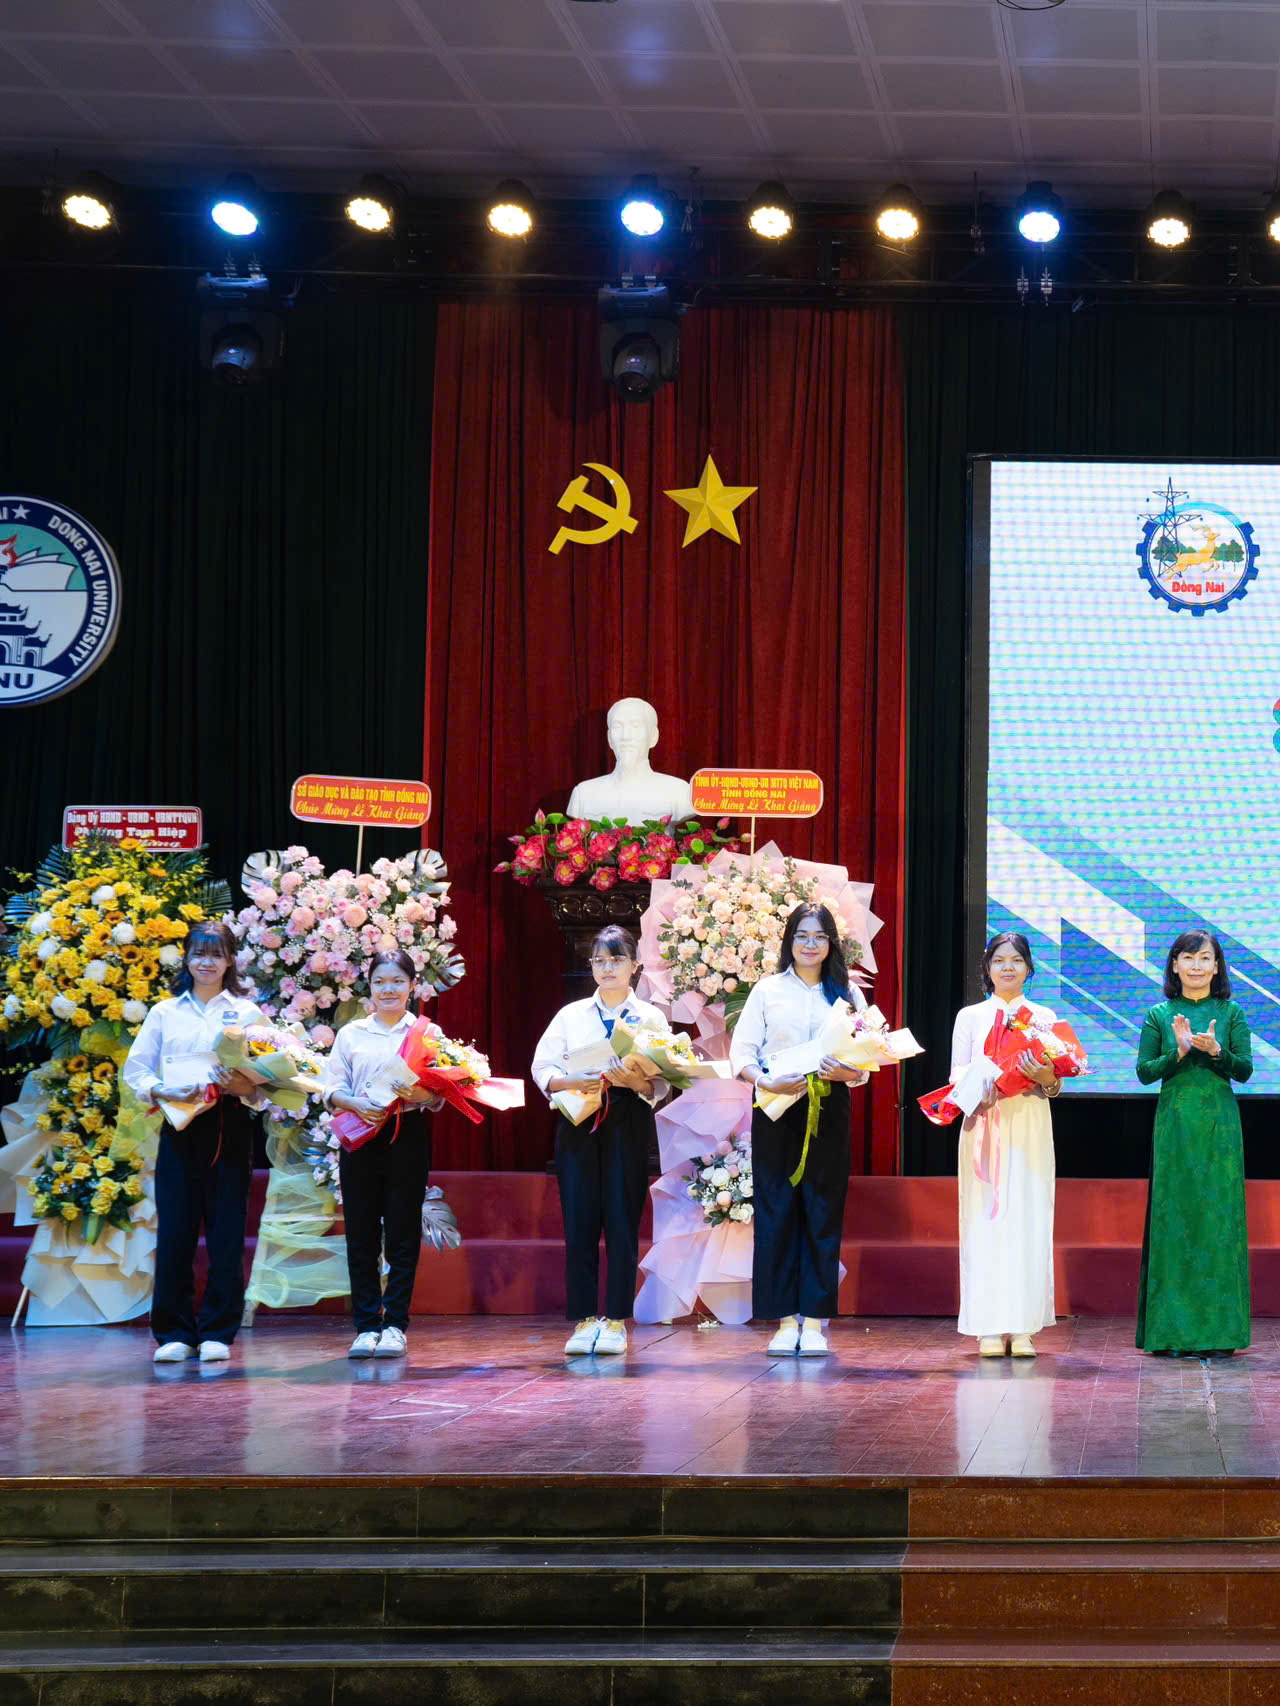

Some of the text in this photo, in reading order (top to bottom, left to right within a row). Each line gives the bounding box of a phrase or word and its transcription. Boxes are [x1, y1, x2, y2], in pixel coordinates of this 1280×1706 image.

[48, 515, 109, 667] DONG NAI UNIVERSITY
[1205, 582, 1225, 593] Nai
[803, 778, 819, 790] NAM
[416, 792, 429, 804] NAI
[770, 790, 786, 799] NAI
[368, 804, 392, 818] Khai
[761, 799, 786, 811] Khai
[158, 827, 187, 838] Hiệp
